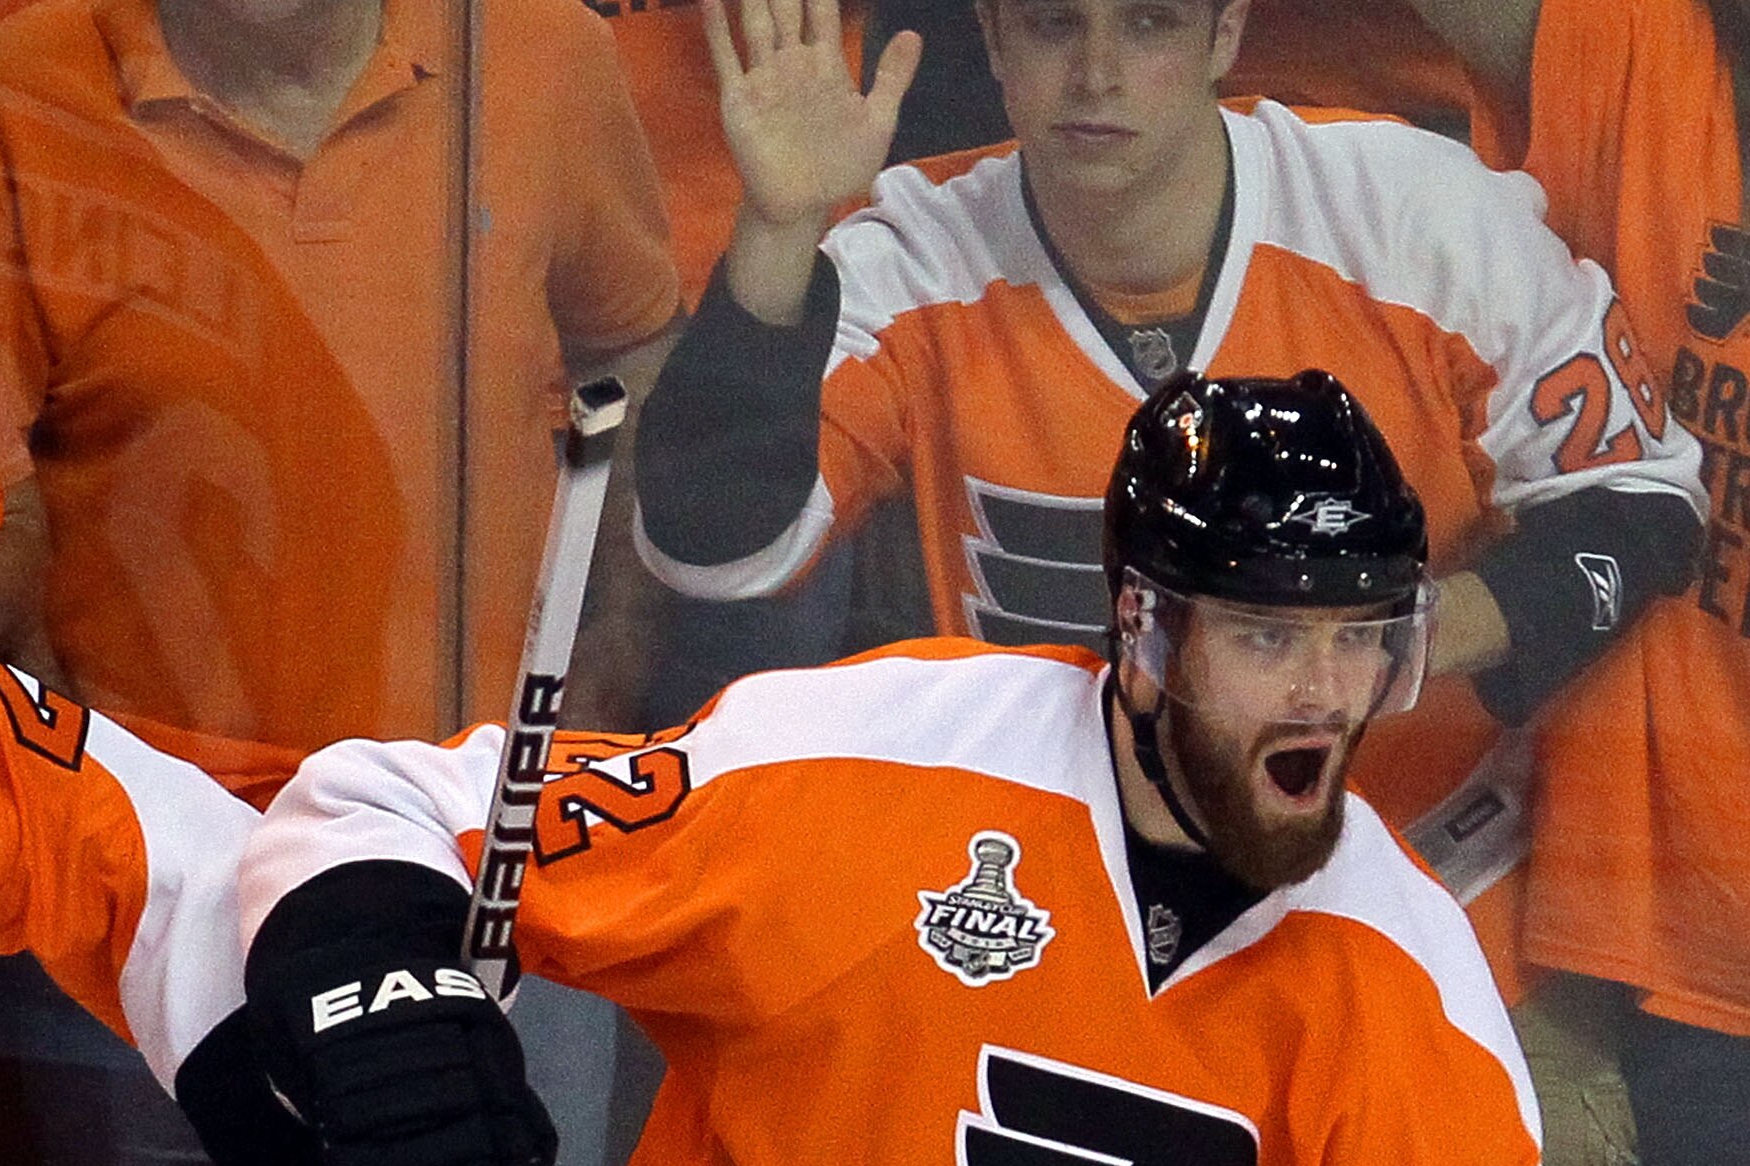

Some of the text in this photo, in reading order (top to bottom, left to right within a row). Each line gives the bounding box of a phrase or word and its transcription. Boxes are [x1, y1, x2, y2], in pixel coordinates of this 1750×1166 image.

[1530, 294, 1668, 475] 28
[930, 903, 1039, 941] FINAL
[311, 968, 487, 1033] EAS
